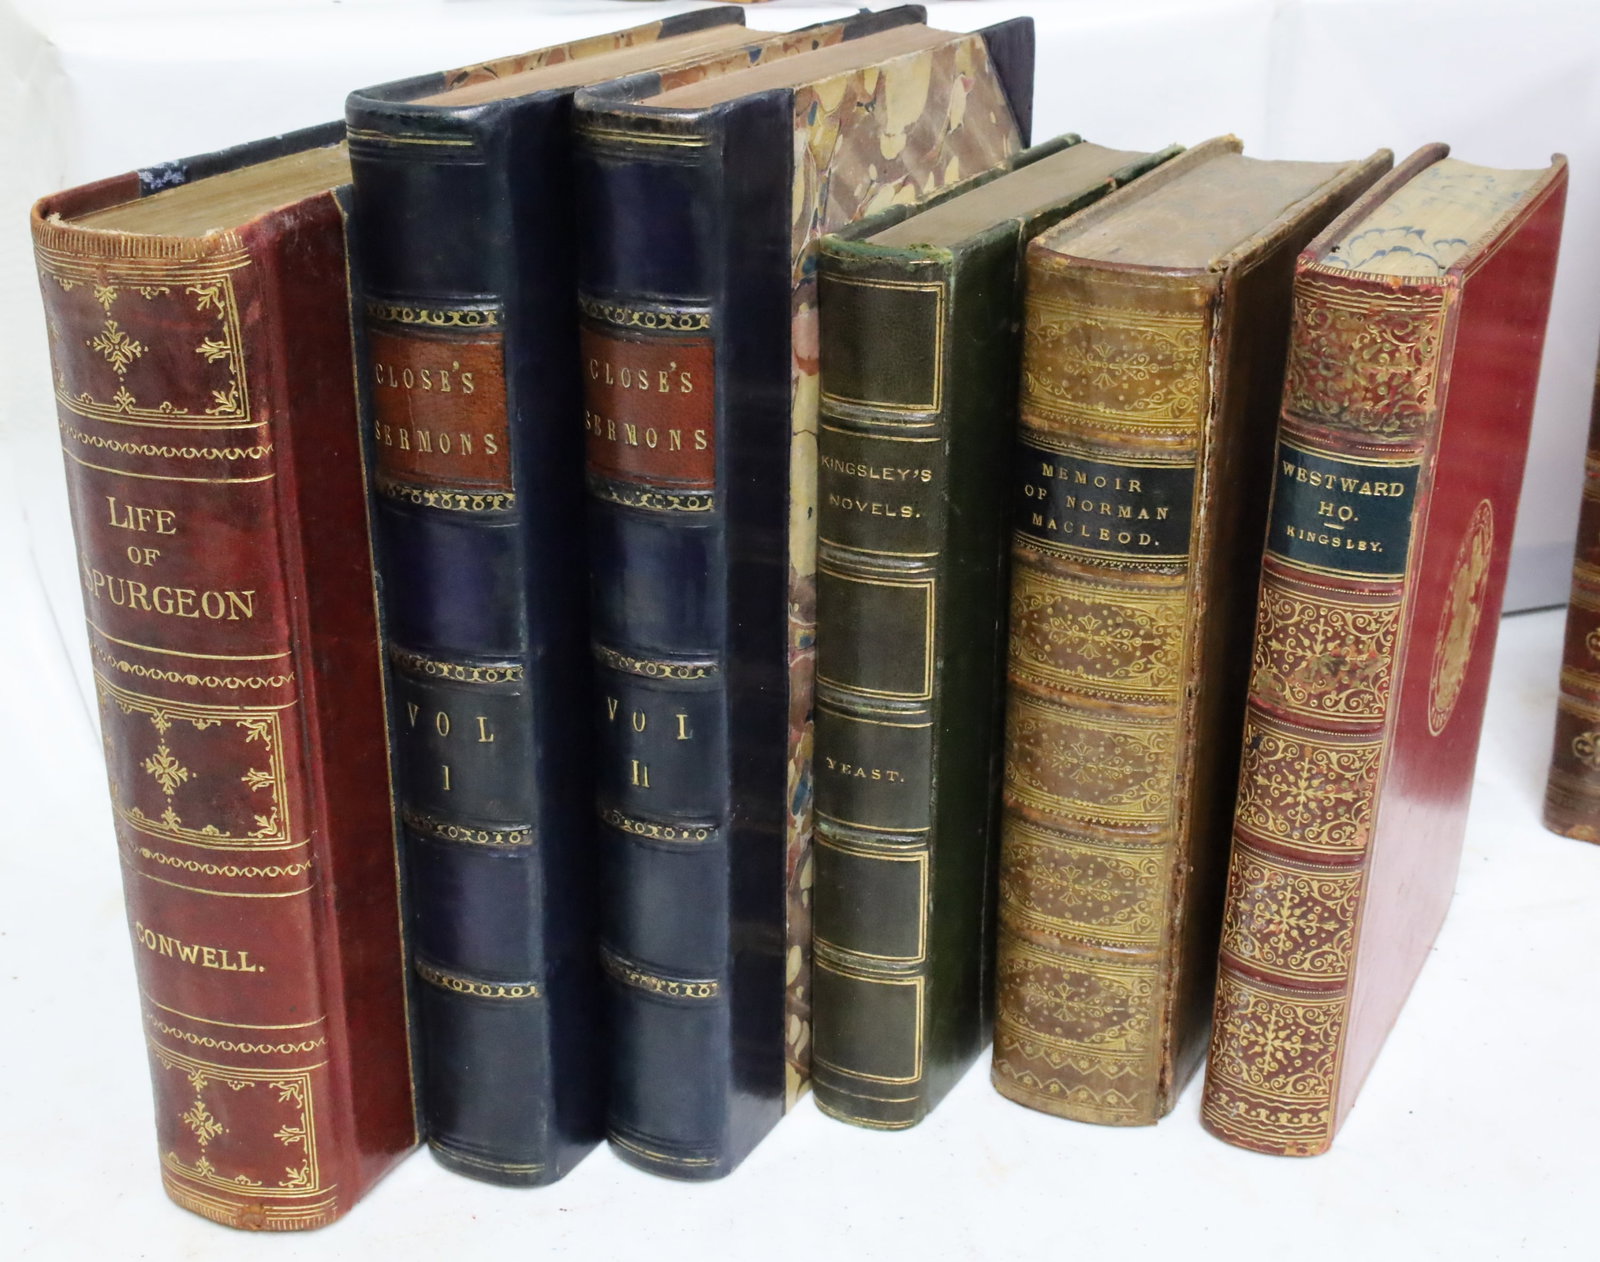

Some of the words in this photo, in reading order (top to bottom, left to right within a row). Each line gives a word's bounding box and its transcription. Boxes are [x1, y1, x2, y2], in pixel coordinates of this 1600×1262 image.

[375, 360, 475, 395] CLOSE'S
[590, 359, 693, 393] CLOSE'S
[374, 419, 498, 456] SERMONS
[584, 409, 708, 451] SERMONS
[821, 455, 933, 483] KINGSLEY'S
[1041, 462, 1142, 493] MEMOIR
[1282, 460, 1405, 497] WESTWARD
[106, 496, 176, 535] LIFE
[829, 493, 921, 519] NOVELS.
[1024, 484, 1047, 500] OF
[1065, 495, 1169, 520] NORMAN
[1318, 501, 1359, 522] HO.
[1032, 512, 1160, 547] MACLEOD.
[1286, 525, 1383, 553] KINGSLEY.
[127, 546, 161, 567] OF
[82, 552, 256, 621] SPURGEON
[407, 702, 494, 742] VOL
[607, 697, 693, 740] VOL
[826, 756, 905, 783] YEAST.
[136, 921, 266, 973] CONWELL.
